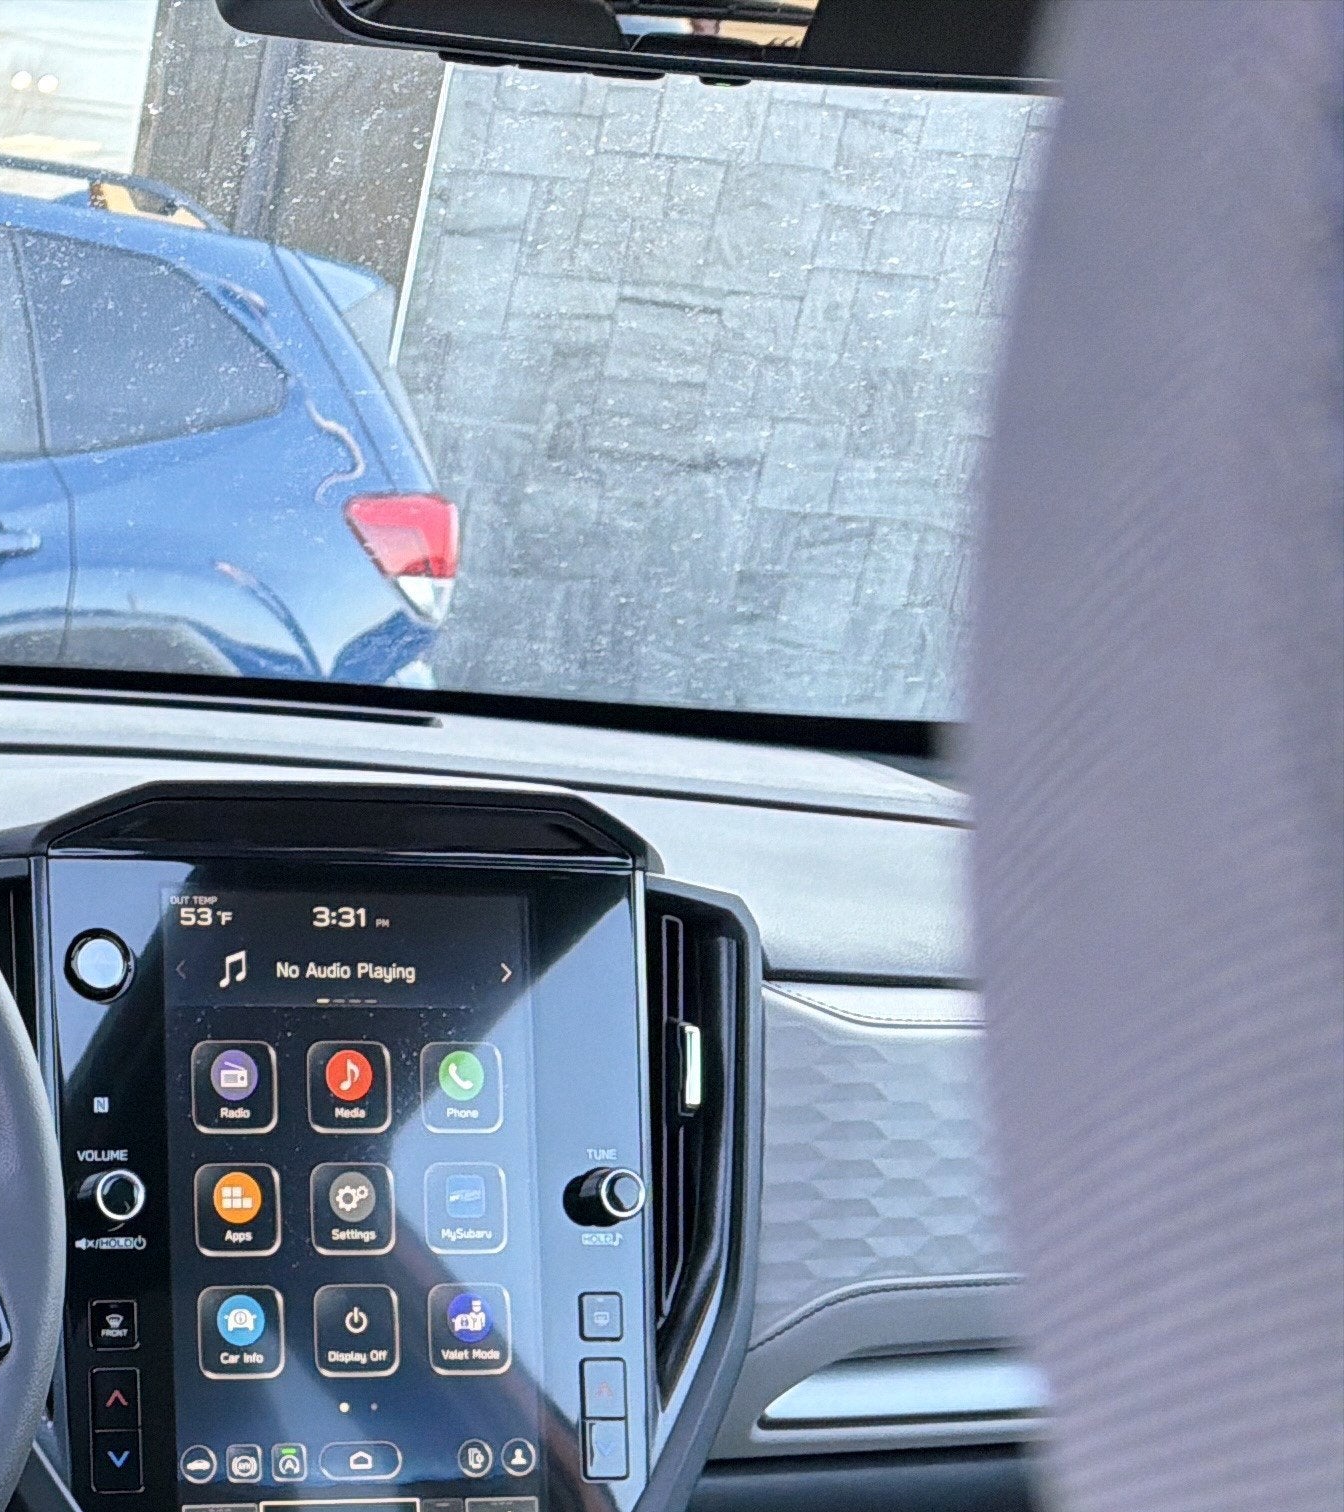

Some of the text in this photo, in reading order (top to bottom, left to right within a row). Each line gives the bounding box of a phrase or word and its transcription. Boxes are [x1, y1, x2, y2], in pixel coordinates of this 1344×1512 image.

[180, 907, 212, 926] 53
[312, 906, 367, 928] 3:31
[276, 961, 416, 984] No Audio Playing
[220, 1107, 251, 1119] Radio
[334, 1107, 366, 1119] Media
[446, 1107, 479, 1119] Phone
[76, 1149, 129, 1162] VOLUME
[586, 1149, 618, 1160] TUNE
[224, 1229, 253, 1243] Apps
[331, 1228, 377, 1242] Settings
[441, 1228, 492, 1241] MySubaru
[220, 1352, 264, 1364] Car Info
[327, 1349, 388, 1365] Display Off
[441, 1348, 500, 1361] Valet Mode
